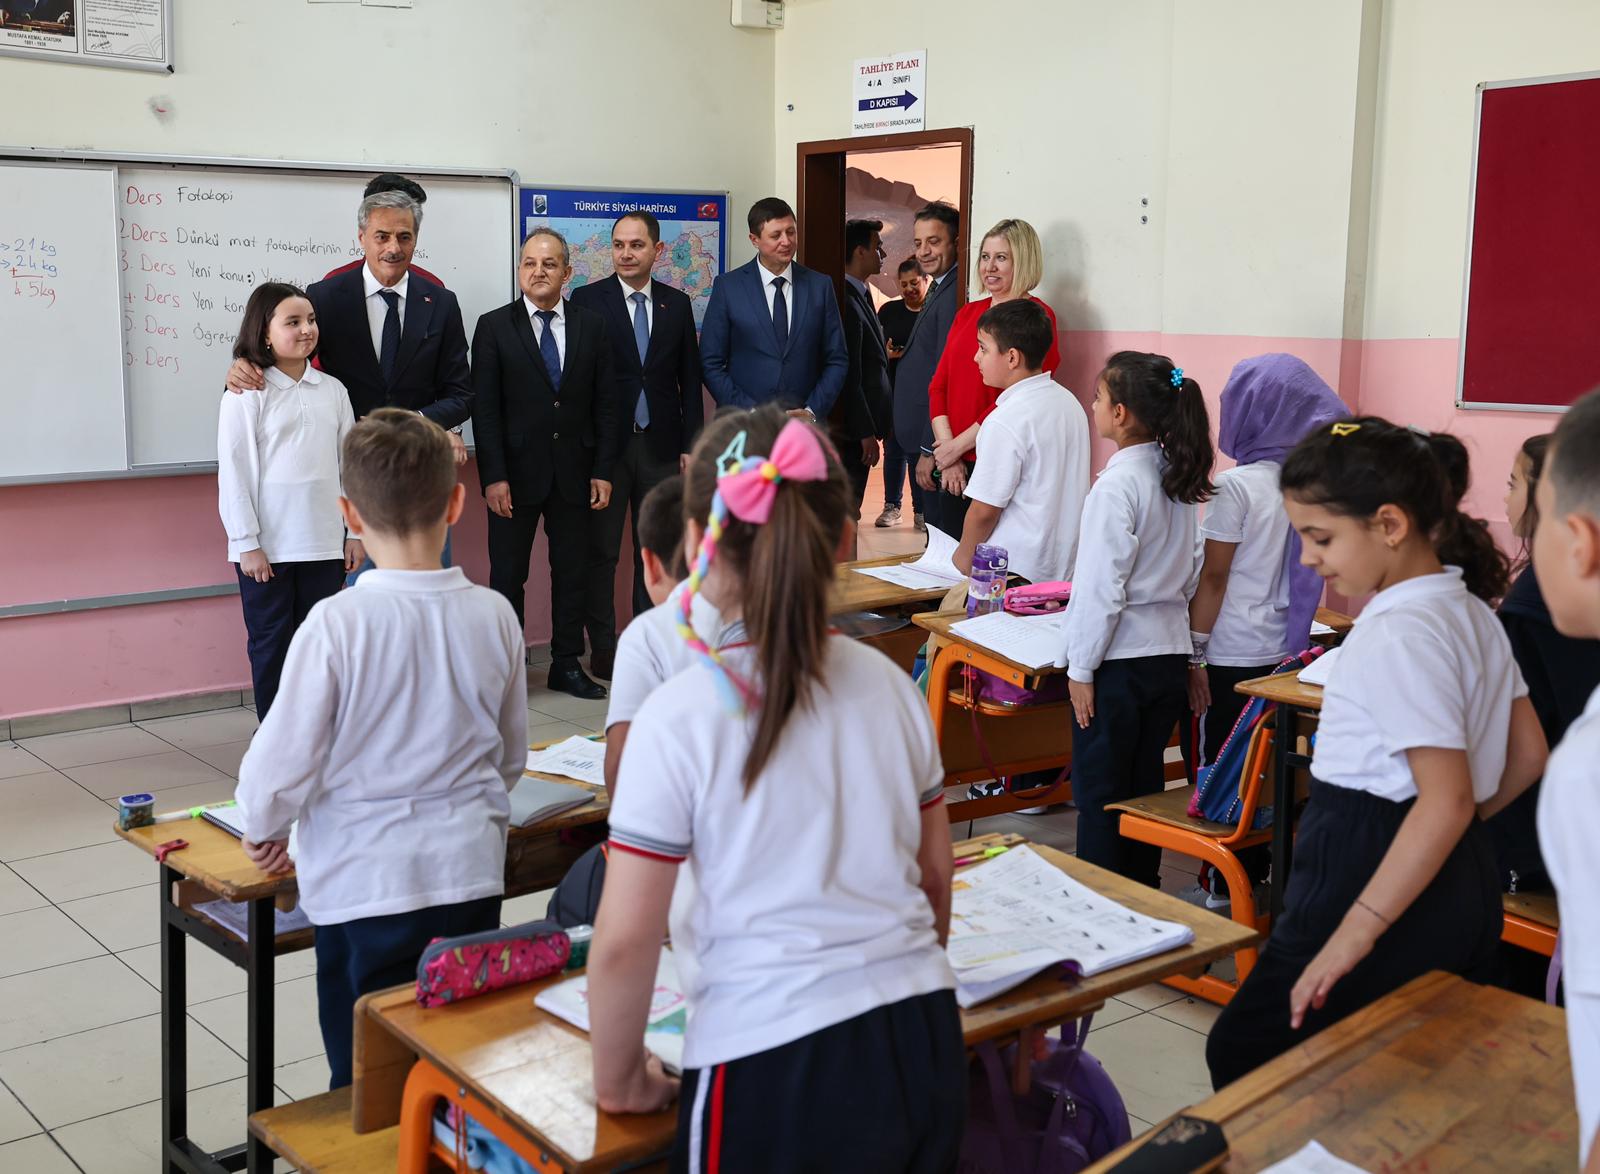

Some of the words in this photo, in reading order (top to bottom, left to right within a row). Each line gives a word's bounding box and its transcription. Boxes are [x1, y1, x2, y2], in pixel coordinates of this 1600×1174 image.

[860, 61, 894, 75] TAHLİYE
[896, 59, 919, 70] PLANI
[892, 75, 911, 84] SINIFI
[869, 100, 875, 108] D
[876, 98, 898, 107] KAPISI
[126, 185, 162, 205] Ders
[177, 186, 233, 203] Fotokopi
[574, 201, 610, 212] TÜRKİYE
[612, 201, 638, 212] SİYASİ
[640, 203, 677, 213] HARİTASI
[14, 238, 35, 251] 21
[131, 223, 168, 242] Ders
[176, 226, 219, 246] Dünkü
[229, 236, 256, 248] mat
[141, 253, 176, 275] Ders
[187, 259, 211, 278] Yeni
[144, 283, 180, 308] Ders
[192, 291, 214, 311] Yeni
[224, 296, 246, 313] kon
[144, 314, 178, 339] Ders
[145, 346, 179, 374] Ders
